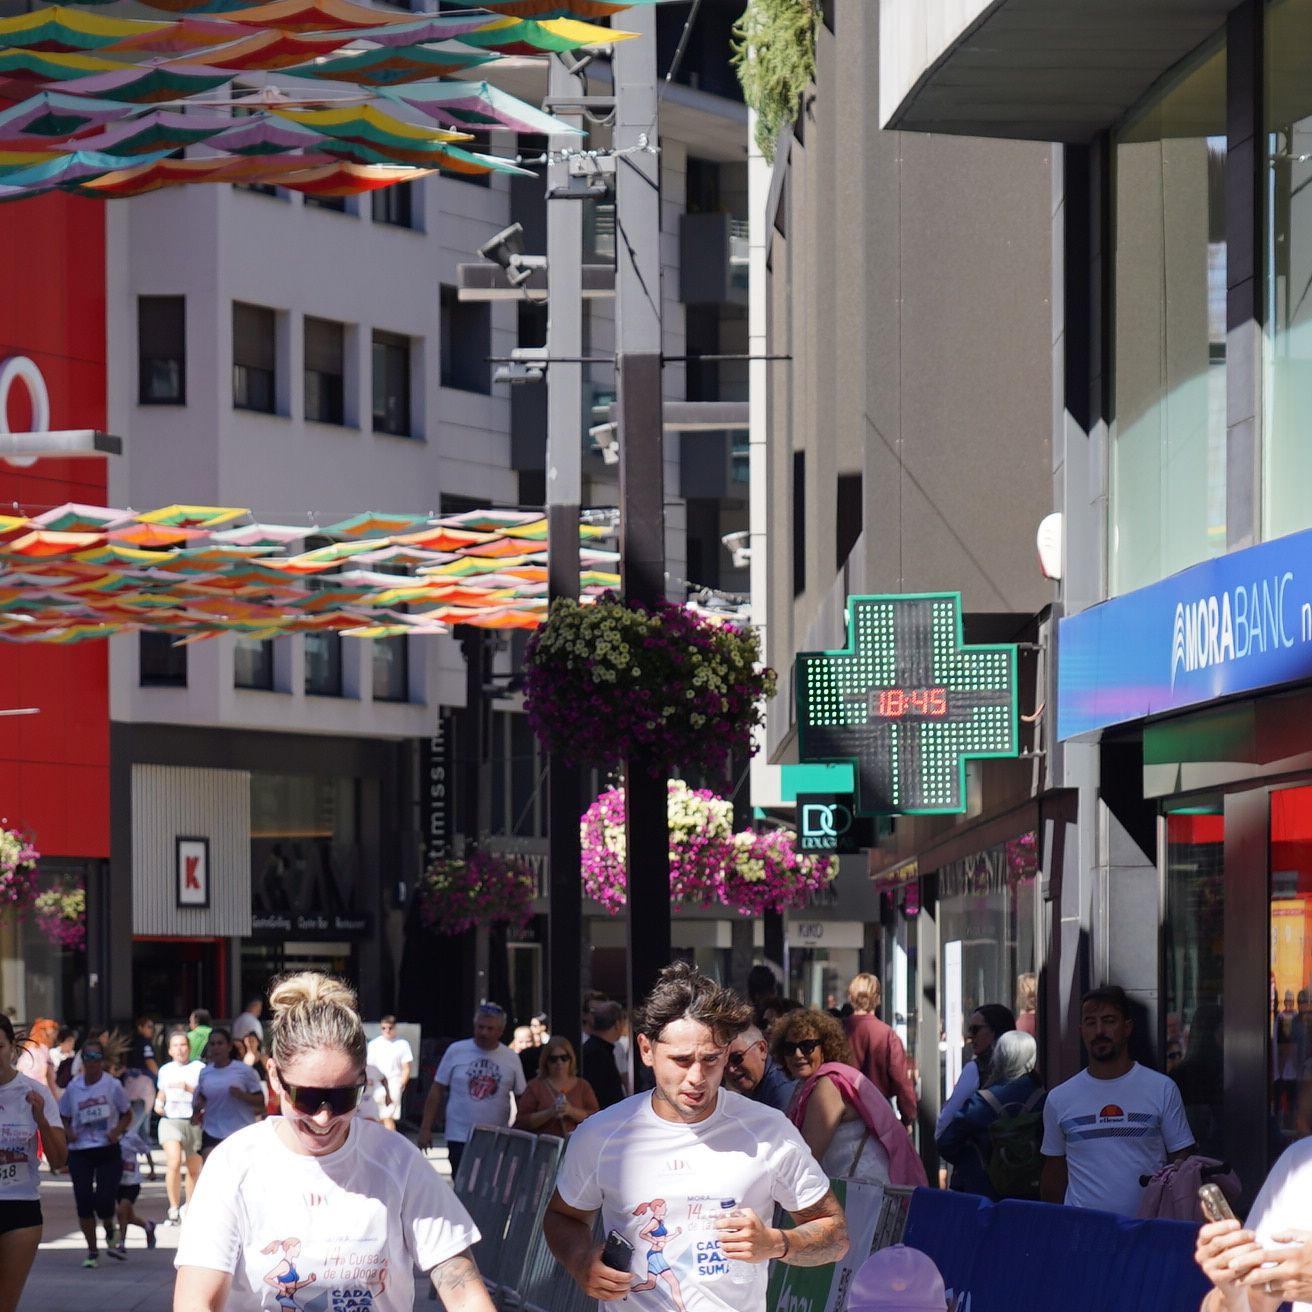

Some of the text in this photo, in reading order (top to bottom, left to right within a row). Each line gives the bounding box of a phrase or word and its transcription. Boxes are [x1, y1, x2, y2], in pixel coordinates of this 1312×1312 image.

[879, 688, 947, 717] 18:45
[185, 855, 201, 890] K
[696, 1240, 721, 1251] CAD
[697, 1252, 727, 1264] PA
[331, 1289, 373, 1299] CADA
